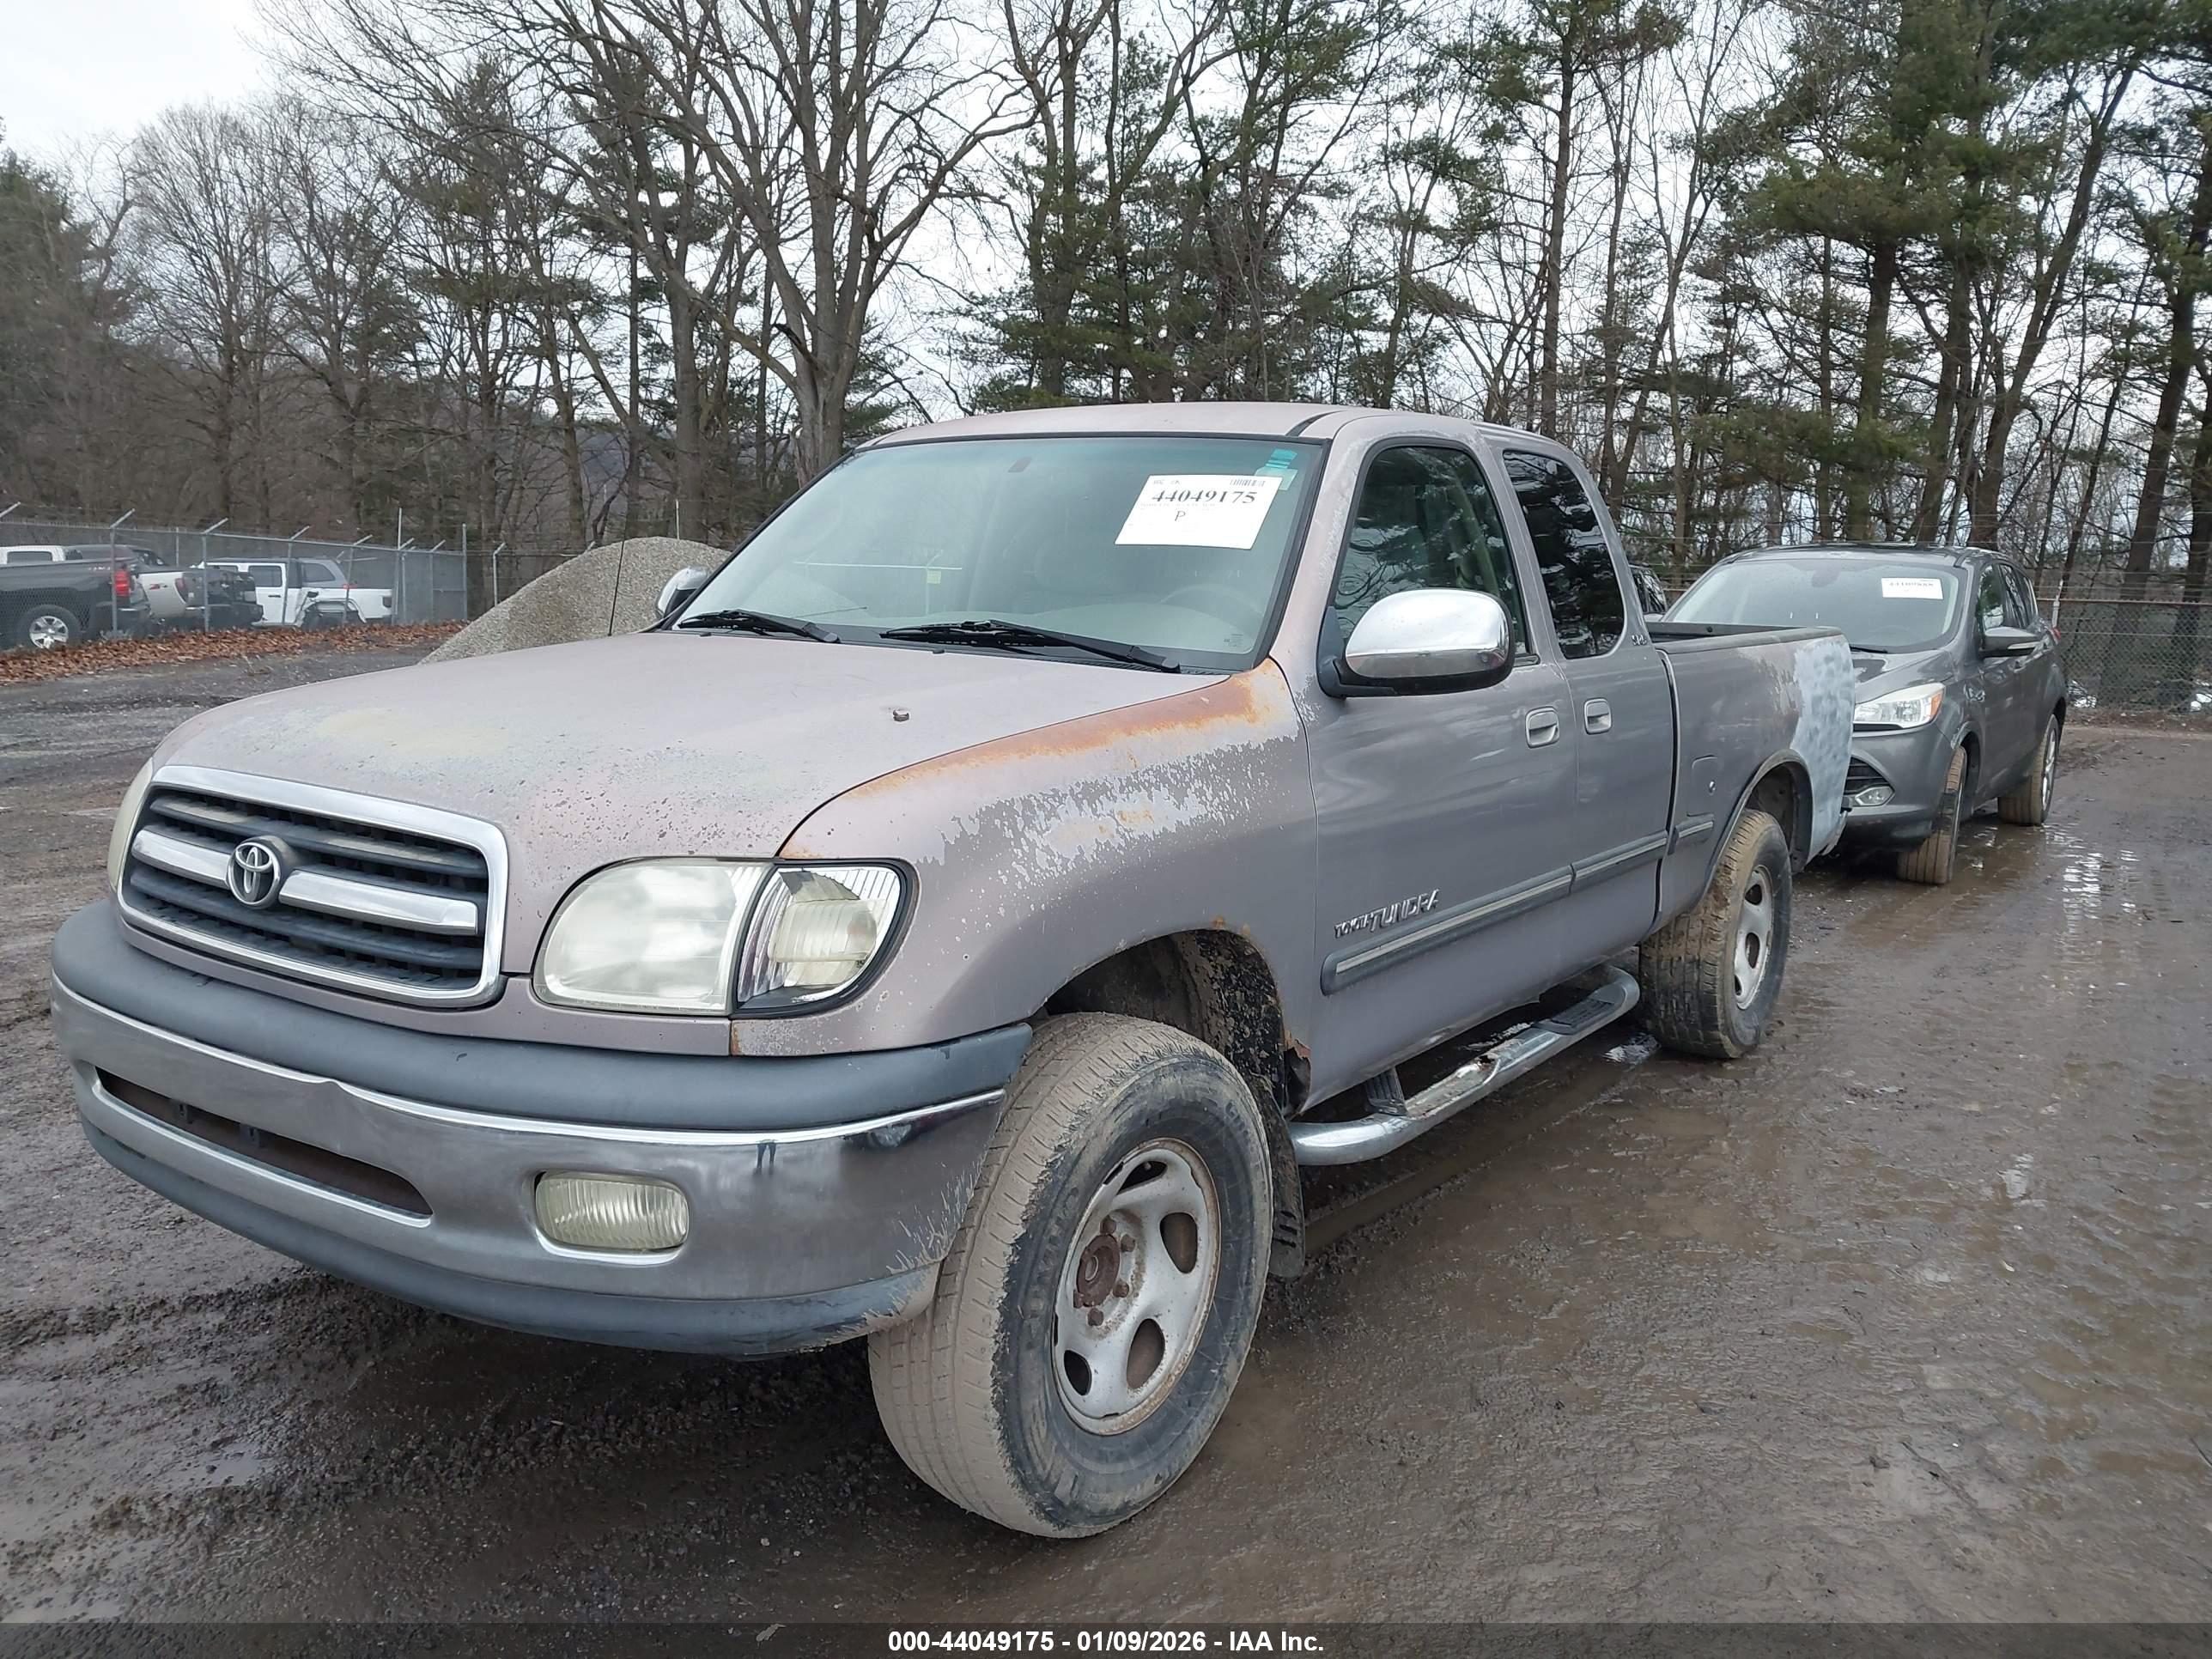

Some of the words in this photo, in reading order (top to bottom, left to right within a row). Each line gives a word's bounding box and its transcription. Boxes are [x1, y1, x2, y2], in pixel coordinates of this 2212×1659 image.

[1152, 489, 1257, 504] 44049175
[1175, 511, 1186, 521] P
[1370, 890, 1439, 932] TUNDRA
